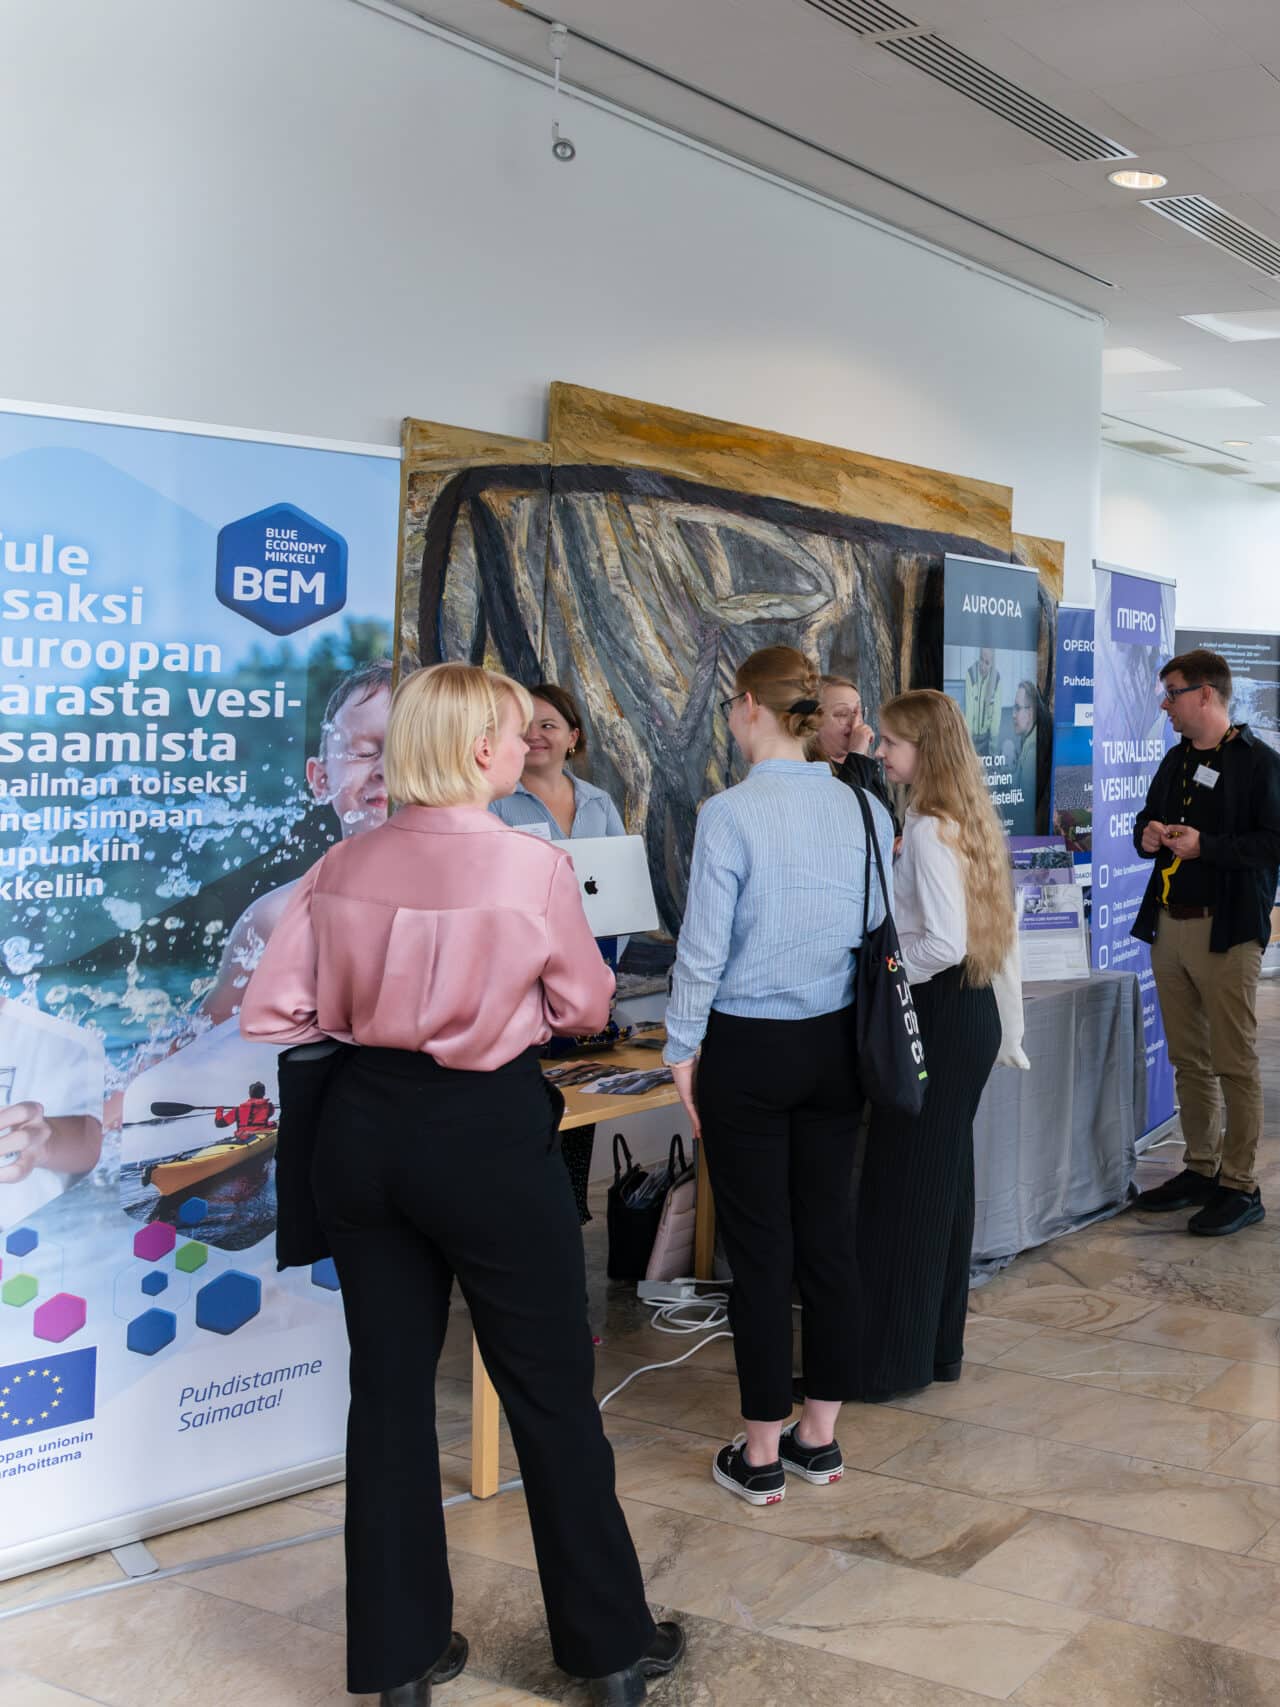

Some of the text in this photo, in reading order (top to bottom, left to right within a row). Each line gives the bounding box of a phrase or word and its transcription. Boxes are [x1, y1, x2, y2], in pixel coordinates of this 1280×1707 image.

[265, 528, 299, 540] BLUE
[265, 540, 327, 553] ECONOMY
[0, 531, 90, 576] ule
[264, 551, 316, 565] MIKKELI
[233, 566, 326, 605] BEM
[962, 593, 1022, 618] AUROORA
[1117, 607, 1156, 633] MIPRO
[187, 681, 302, 718] vesi-
[994, 754, 1005, 766] on
[128, 771, 247, 795] toiseksi
[179, 1359, 322, 1407] Puhdistamme
[178, 1389, 283, 1432] Saimaata!
[38, 1431, 94, 1453] unionin
